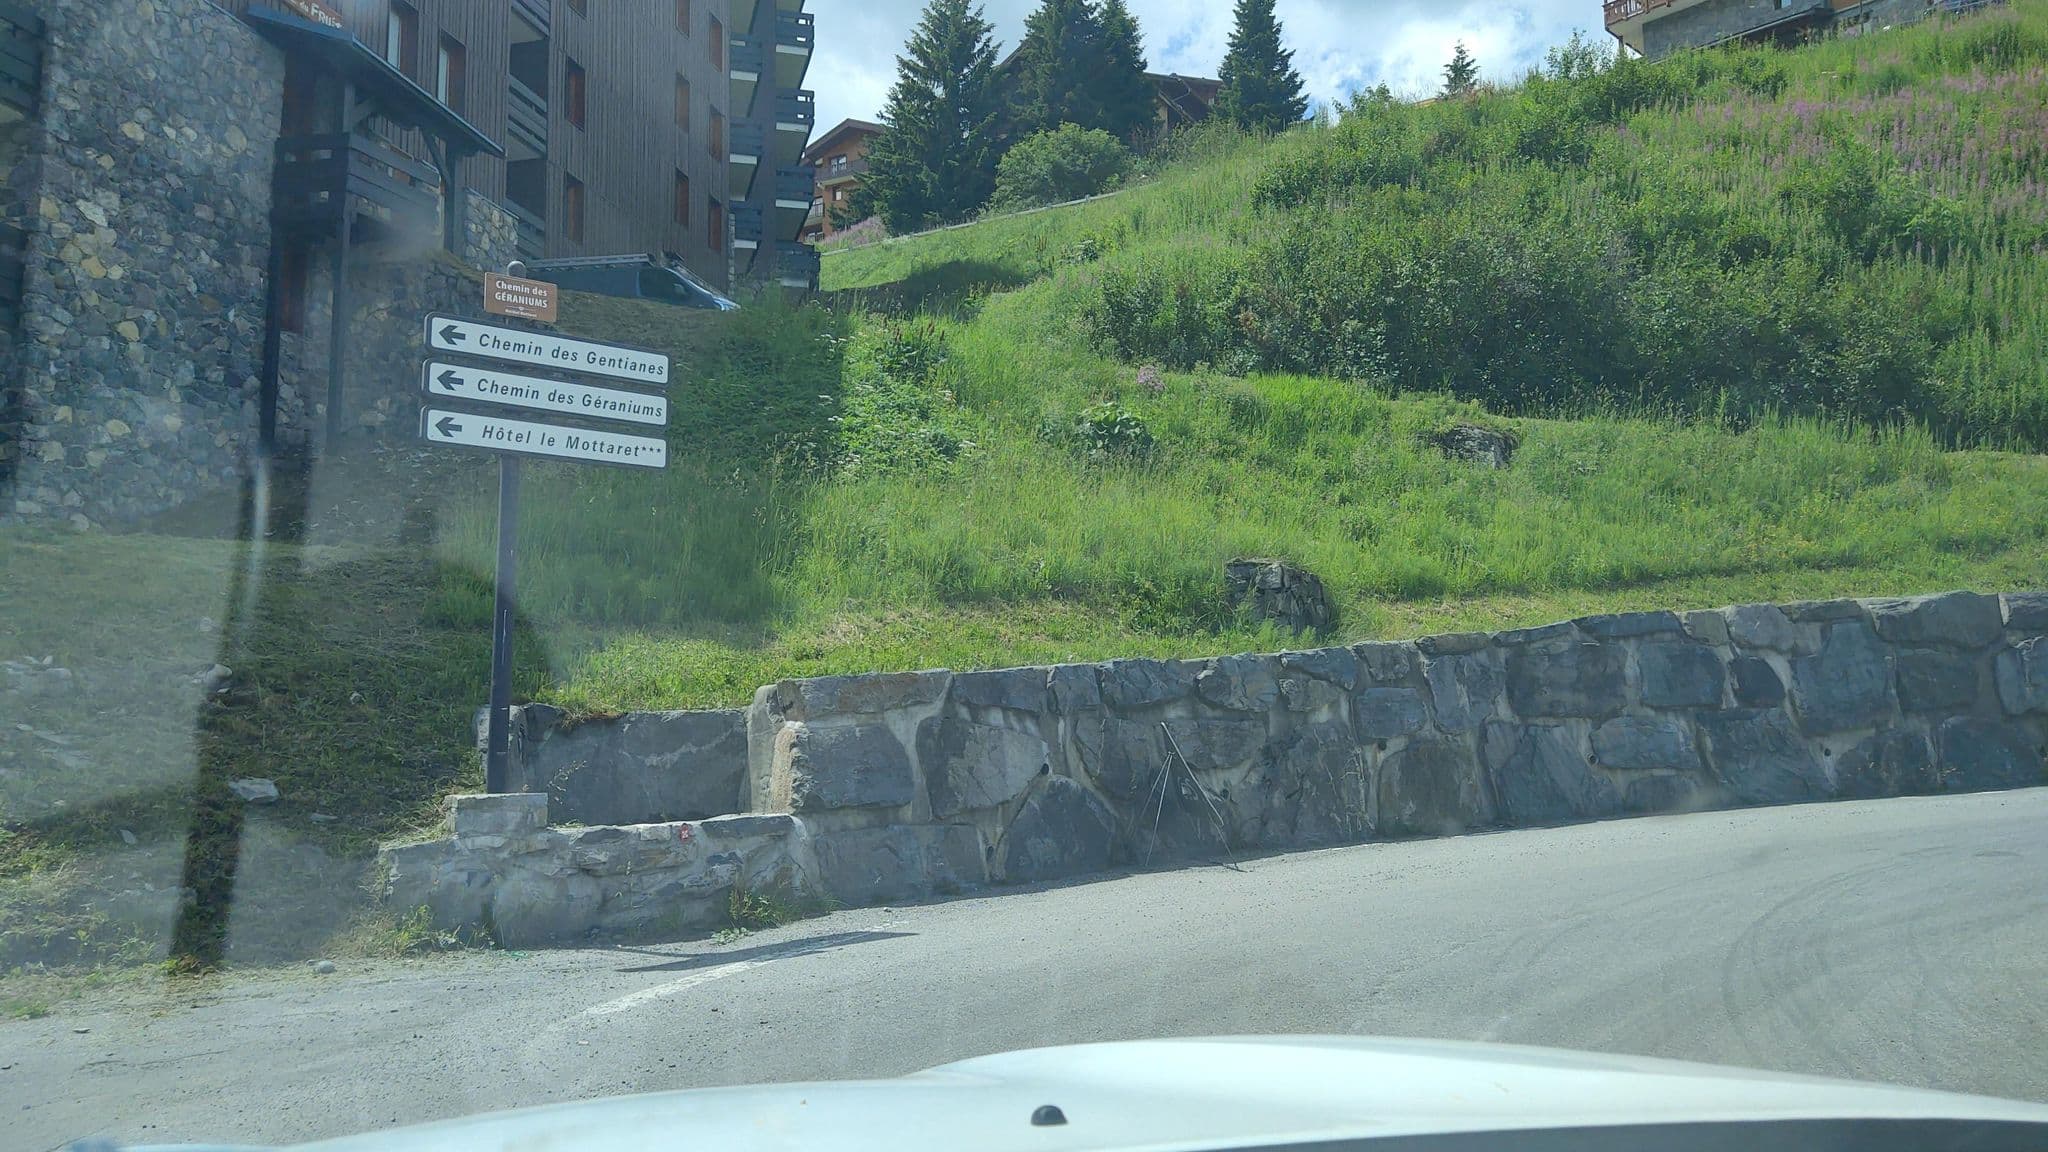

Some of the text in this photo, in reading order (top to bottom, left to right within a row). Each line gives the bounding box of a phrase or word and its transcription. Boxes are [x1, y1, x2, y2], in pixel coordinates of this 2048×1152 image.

[494, 291, 548, 308] GÉRANIUMS
[495, 280, 548, 297] Chemin des
[479, 333, 665, 376] Chemin des Gentianes
[477, 378, 663, 417] Chemin des Géraniums
[481, 424, 532, 444] Hôtel
[540, 432, 556, 447] le
